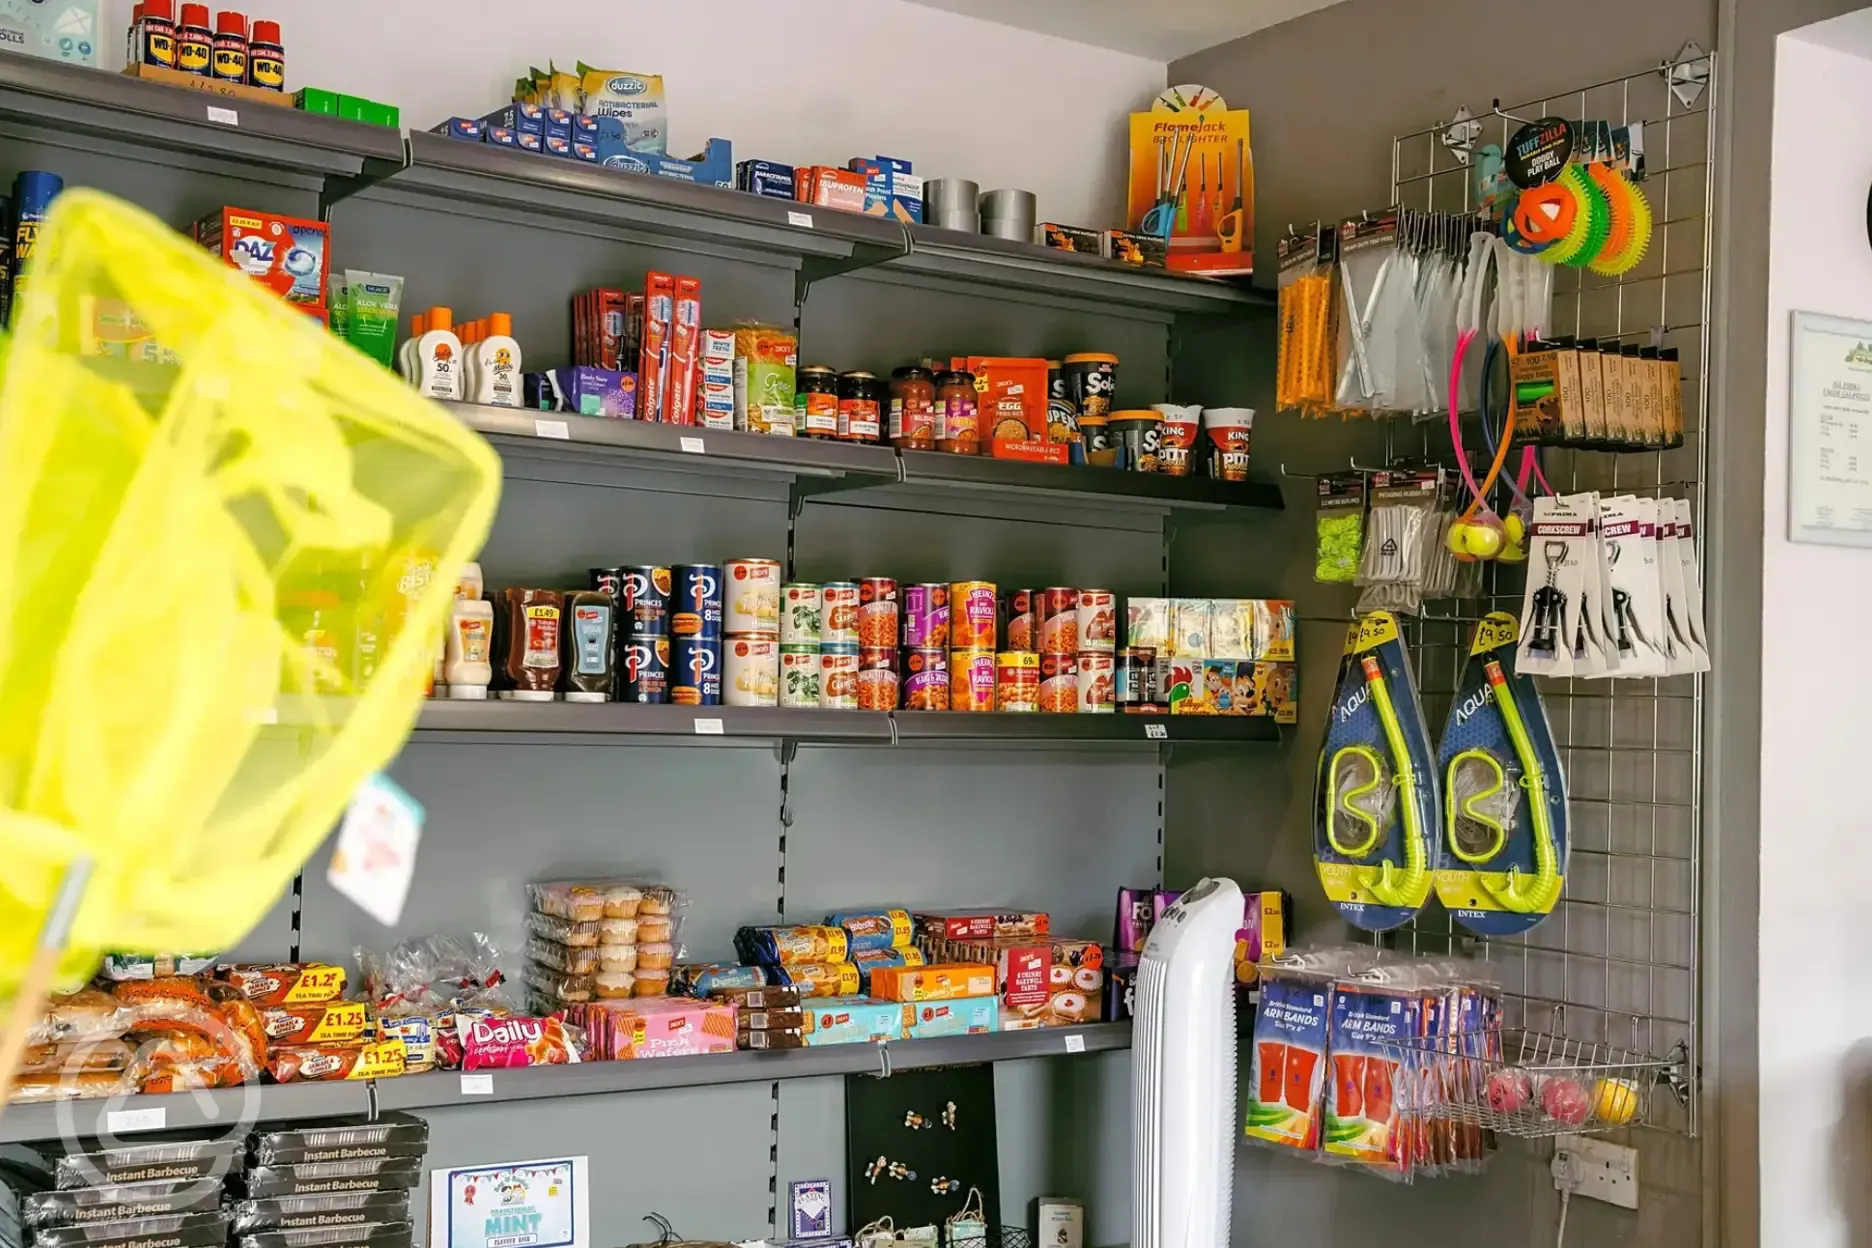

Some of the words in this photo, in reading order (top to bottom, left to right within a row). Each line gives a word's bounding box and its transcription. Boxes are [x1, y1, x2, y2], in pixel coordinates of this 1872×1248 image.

[216, 52, 244, 67] WD-40
[256, 62, 282, 77] WD-40
[598, 99, 659, 110] ANTIBACTERIAL
[597, 107, 633, 118] Wipes
[1516, 123, 1567, 157] TUFFZILLA
[1531, 150, 1555, 166] DOGGY
[1527, 163, 1545, 178] PLAY
[1544, 156, 1561, 171] BALL
[819, 179, 864, 194] IBUPROFEN
[233, 239, 278, 262] DAZ
[333, 302, 348, 310] ALO
[436, 363, 450, 373] 50
[645, 378, 655, 422] Colgate
[671, 381, 682, 425] Colgate
[997, 401, 1022, 411] EGG
[1046, 409, 1078, 432] UPER
[1537, 524, 1582, 535] CORKSCREW
[971, 589, 993, 599] HEINZ
[634, 598, 662, 607] PRINCES
[704, 599, 722, 608] PRINC
[534, 607, 554, 617] £1.49
[704, 609, 712, 620] 8
[638, 671, 665, 679] PRINCES
[703, 672, 720, 680] PRINC
[703, 682, 710, 694] 8
[1455, 683, 1493, 726] AQUA
[1321, 866, 1351, 877] YOUTH
[1435, 873, 1470, 883] YOUTH
[1340, 902, 1365, 912] INTEX
[1458, 909, 1486, 919] INTEX
[1286, 1004, 1312, 1014] Standard
[325, 1012, 363, 1027] £1.25
[1263, 1008, 1284, 1019] ARM
[1284, 1011, 1319, 1026] BANDS
[1363, 1013, 1390, 1022] Standard
[472, 1019, 543, 1045] Daily
[1341, 1020, 1362, 1030] ARM
[1363, 1021, 1397, 1034] BANDS
[364, 1049, 402, 1065] £1.25
[304, 1150, 340, 1161] Instant
[340, 1147, 386, 1159] Barbecue
[106, 1170, 146, 1182] Instant
[147, 1165, 199, 1178] Barbecue
[295, 1183, 331, 1193] Instant
[332, 1179, 379, 1190] Barbecue
[75, 1207, 117, 1219] Instant
[118, 1201, 172, 1215] Barbecue
[280, 1216, 317, 1227] Instant
[318, 1213, 366, 1224] Barbecue
[485, 1212, 543, 1237] MINT
[128, 1236, 181, 1248] Barbecue
